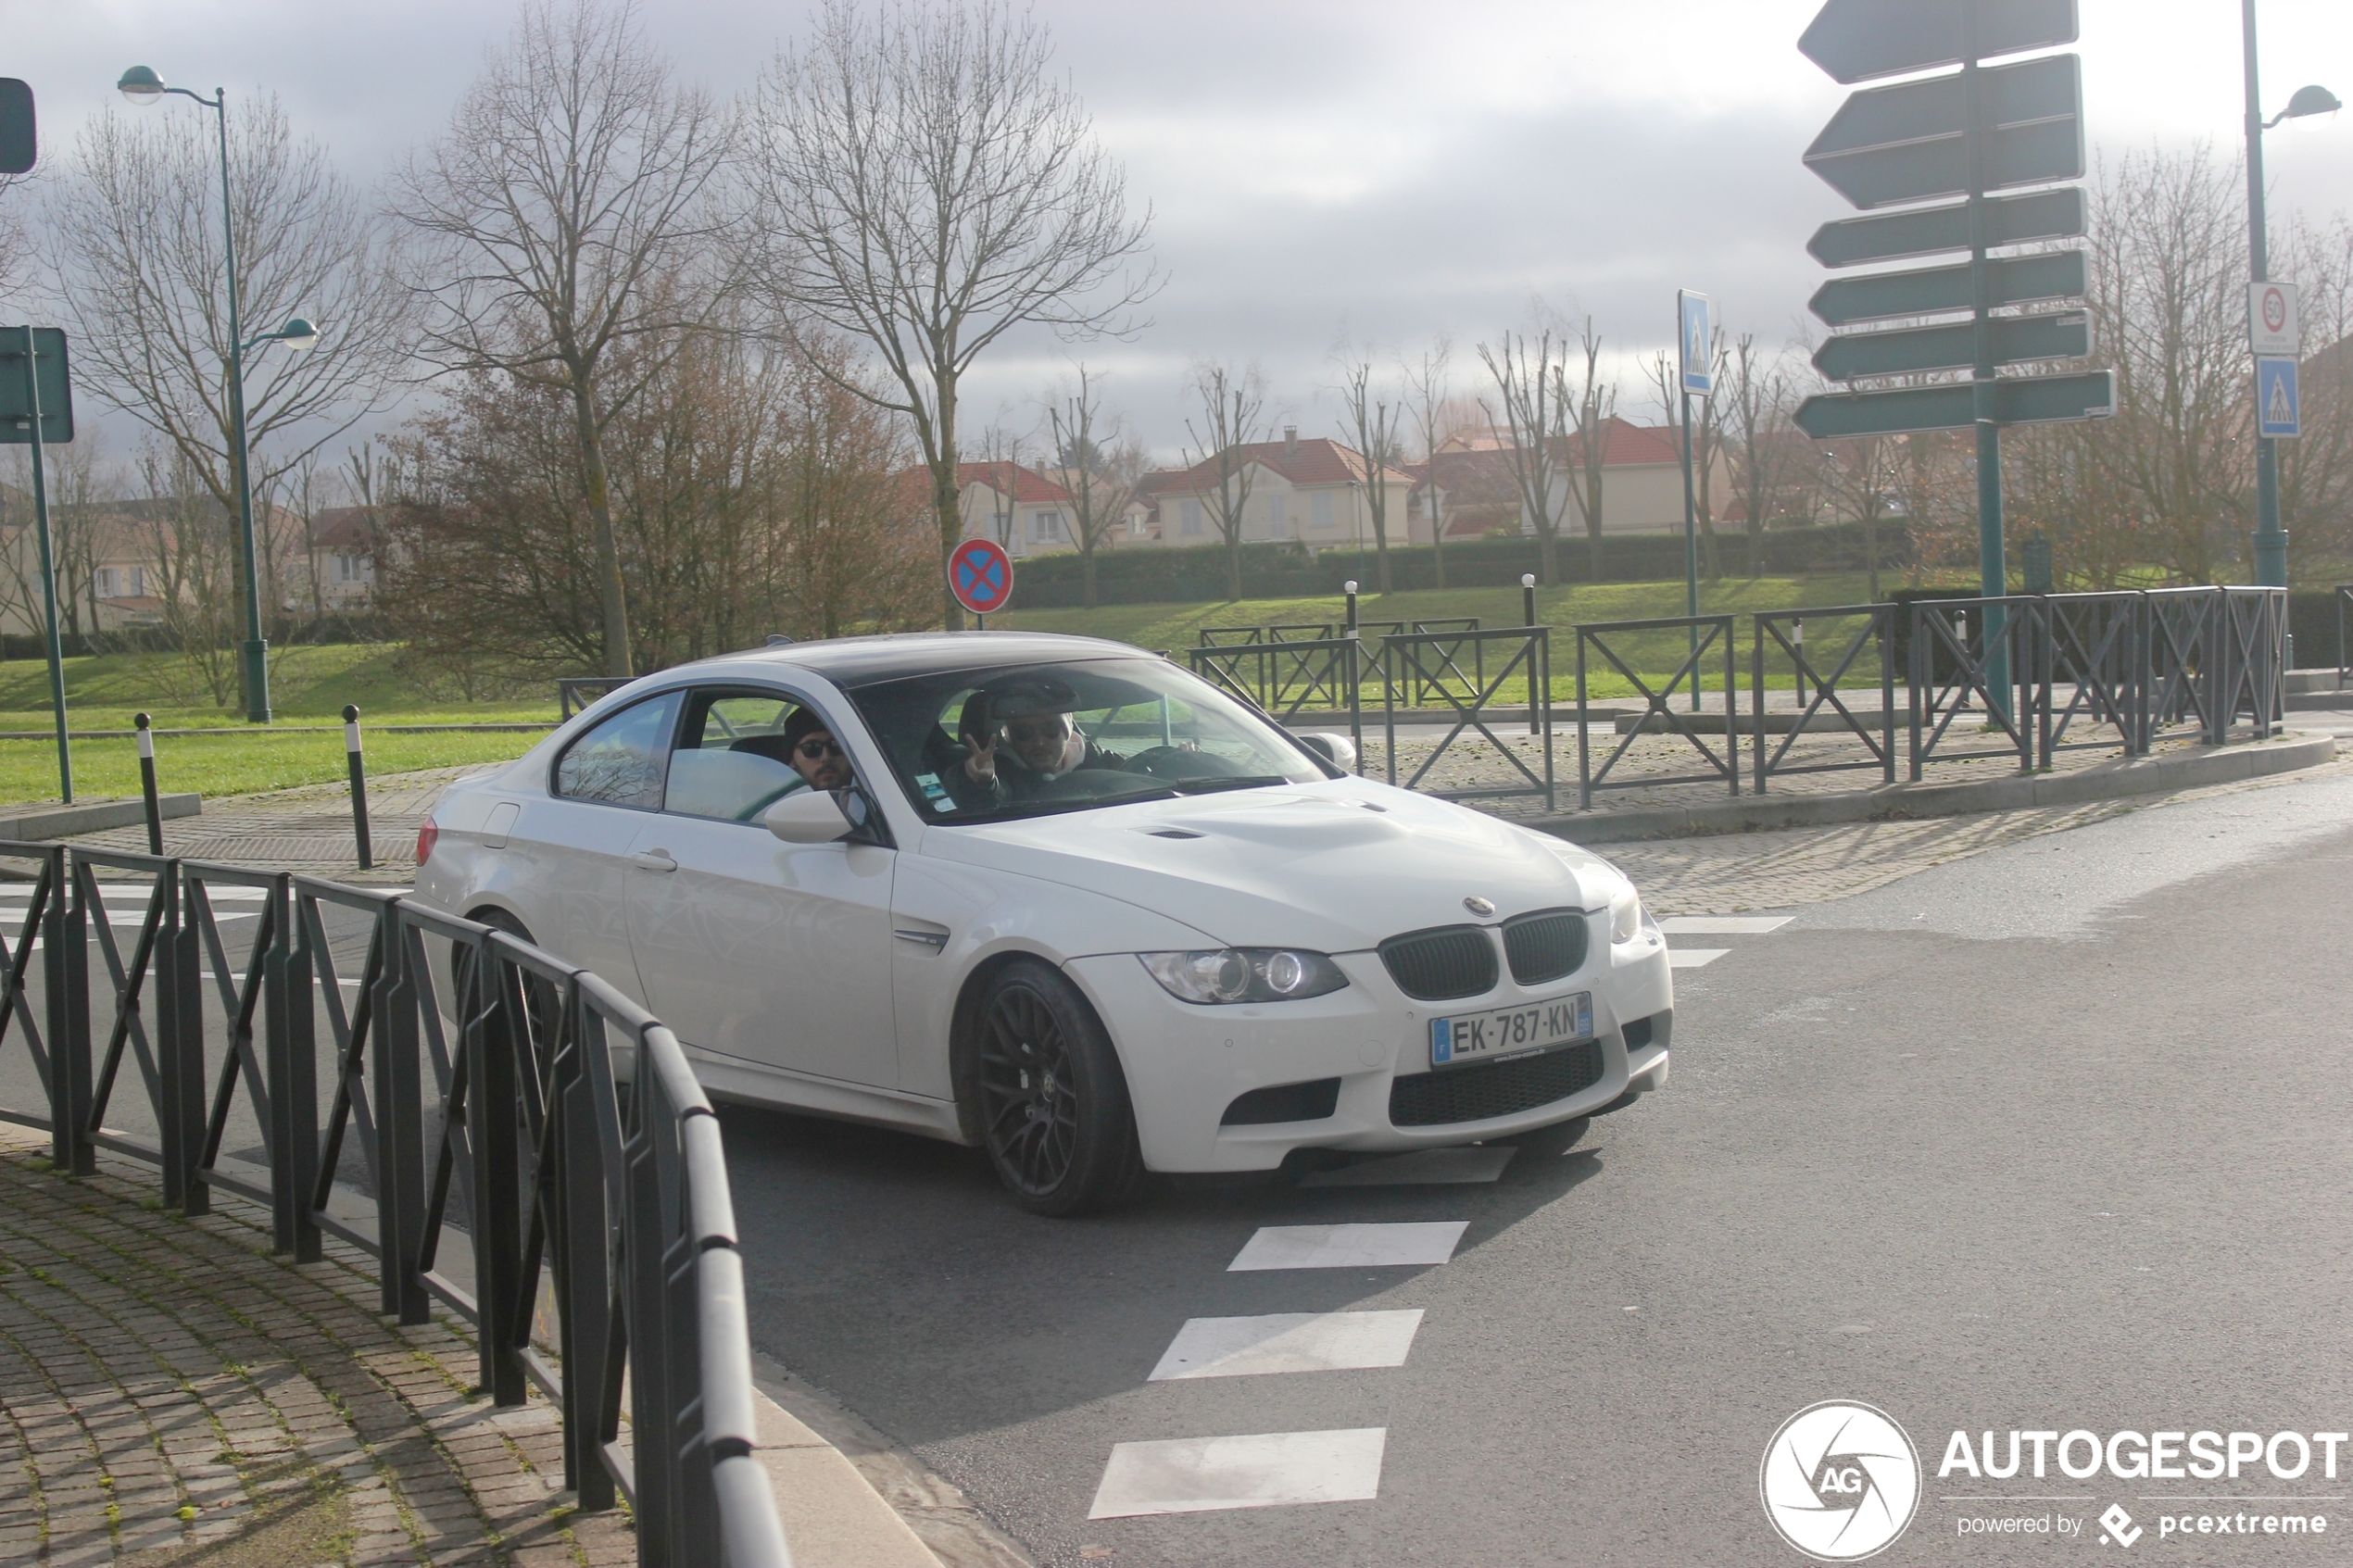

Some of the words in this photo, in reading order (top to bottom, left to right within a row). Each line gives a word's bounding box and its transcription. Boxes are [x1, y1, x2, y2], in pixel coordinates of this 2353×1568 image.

[2267, 300, 2281, 320] 50
[1453, 1002, 1576, 1054] EK-787-KN
[1579, 1017, 1590, 1033] 69
[1439, 1044, 1446, 1055] F
